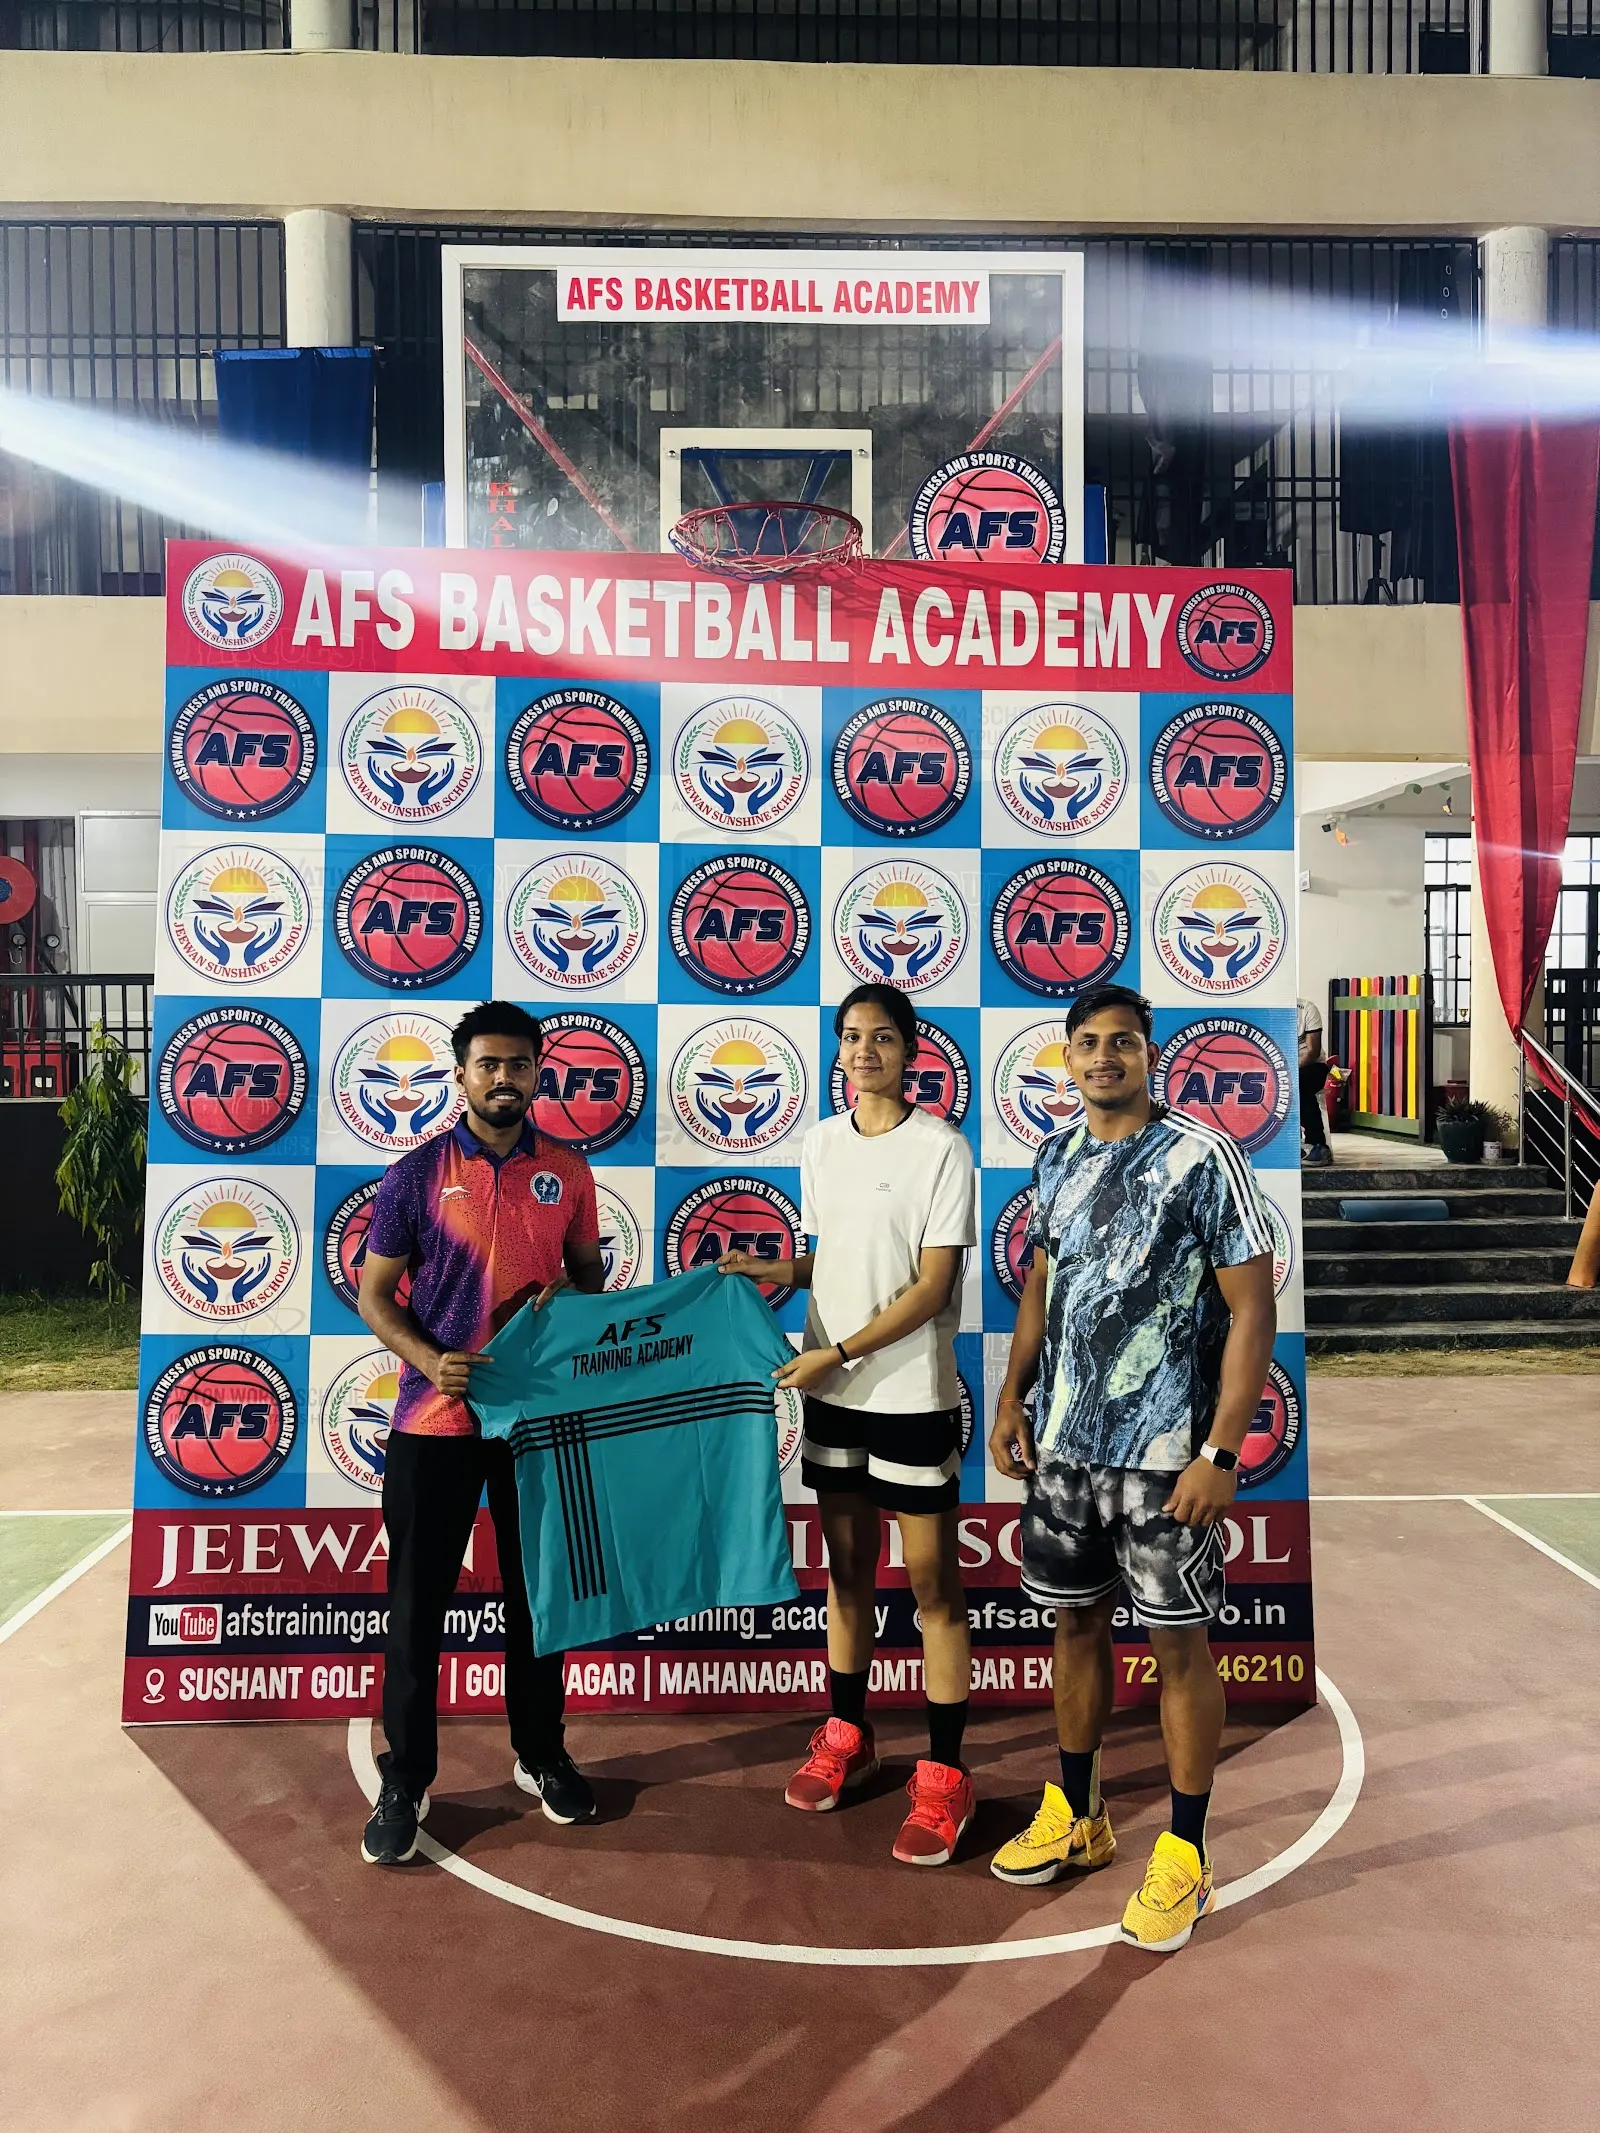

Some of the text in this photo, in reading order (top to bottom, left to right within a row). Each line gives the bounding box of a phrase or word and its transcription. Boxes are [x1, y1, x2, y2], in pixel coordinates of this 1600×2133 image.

[566, 276, 980, 316] AFS BASKETBALL ACADEMY
[915, 453, 1064, 564] FITNESS AND SPORTS TRAINING ACADEMY
[937, 510, 1039, 550] AFS
[188, 606, 211, 637] JEEWAN
[211, 634, 254, 646] SUNSHINE
[254, 609, 278, 639] SCHOOL
[292, 568, 416, 651] AFS
[439, 574, 850, 664] BASKETBALL
[869, 586, 1176, 670] ACADEMY
[1178, 585, 1273, 655] ASHWANI FITNESS AND SPORTS TRAINING ACADEMY
[1194, 620, 1258, 644] AFS
[866, 703, 887, 719] AND
[888, 700, 929, 716] SPORTS
[929, 708, 965, 750] TRAINING
[171, 681, 314, 784] ASHWANI FITNESS AND SPORTS TRAINING ACADEMY
[194, 732, 292, 768] AFS
[508, 691, 647, 794] ASHWANI FITNESS AND SPORTS TRAINING ACADEMY
[838, 713, 868, 750] FITNESS
[531, 742, 626, 778] AFS
[834, 750, 851, 799] ASHWANI
[856, 751, 948, 785] AFS
[1152, 705, 1285, 803] ASHWANI FITNESS AND SPORTS TRAINING ACADEMY
[1174, 755, 1264, 788] AFS
[348, 762, 475, 817] JEEWAN SUNSHINE SCHOOL
[953, 751, 969, 800] ACADEMY
[680, 772, 802, 827] JEEWAN SUNSHINE SCHOOL
[1001, 778, 1121, 831] JEEWAN SUNSHINE SCHOOL
[371, 851, 394, 868] AND
[395, 848, 438, 864] SPORTS
[704, 860, 725, 876] AND
[727, 857, 768, 872] SPORTS
[341, 862, 373, 899] FITNESS
[438, 857, 476, 899] TRAINING
[675, 870, 706, 907] FITNESS
[768, 865, 804, 907] TRAINING
[336, 899, 355, 950] ASHWANI
[360, 900, 458, 936] AFS
[462, 901, 480, 951] ACADEMY
[671, 907, 689, 957] ASHWANI
[693, 908, 787, 942] AFS
[993, 861, 1128, 961] ASHWANI FITNESS AND SPORTS TRAINING ACADEMY
[1015, 912, 1106, 945] AFS
[174, 922, 302, 978] JEEWAN SUNSHINE SCHOOL
[792, 908, 808, 957] ACADEMY
[514, 930, 639, 984] JEEWAN SUNSHINE SCHOOL
[840, 936, 961, 989] JEEWAN SUNSHINE SCHOOL
[1160, 938, 1280, 990] JEEWAN SUNSHINE SCHOOL
[159, 1009, 305, 1114] ASHWANI FITNESS AND SPORTS TRAINING ACADEMY
[183, 1063, 283, 1099] AFS
[561, 1015, 603, 1031] SPORTS
[603, 1023, 640, 1065] TRAINING
[627, 1066, 644, 1117] ACADEMY
[927, 1027, 968, 1119] TRAINING ACADEMY
[1157, 1020, 1290, 1120] FITNESS AND SPORTS TRAINING ACADEMY
[533, 1067, 622, 1102] AFS
[1176, 1072, 1268, 1105] AFS
[339, 1091, 434, 1147] JEEWAN SUNSHINE
[677, 1094, 800, 1148] JEEWAN SUNSHINE SCHOOL
[1000, 1097, 1032, 1139] JEEWAN
[671, 1179, 802, 1232] FITNESS AND SPORTS TRAINING
[326, 1193, 364, 1284] ASHWANI FITNESS
[161, 1259, 291, 1315] JEEWAN SUNSHINE SCHOOL
[595, 1312, 667, 1347] AFS
[183, 1351, 206, 1369] AND
[208, 1348, 252, 1364] SPORTS
[572, 1333, 694, 1380] TRAINING ACADEMY
[152, 1363, 185, 1403] FITNESS
[252, 1356, 290, 1401] TRAINING
[147, 1403, 165, 1457] ASHWANI
[171, 1403, 272, 1439] AFS
[276, 1402, 294, 1455] ACADEMY
[329, 1431, 362, 1477] JEEWAN
[179, 1666, 304, 1702] SUSHANT
[311, 1665, 375, 1699] GOLF
[564, 1663, 635, 1696] AGAR
[660, 1660, 826, 1694] MAHANAGAR
[1122, 1655, 1304, 1683] 7246210
